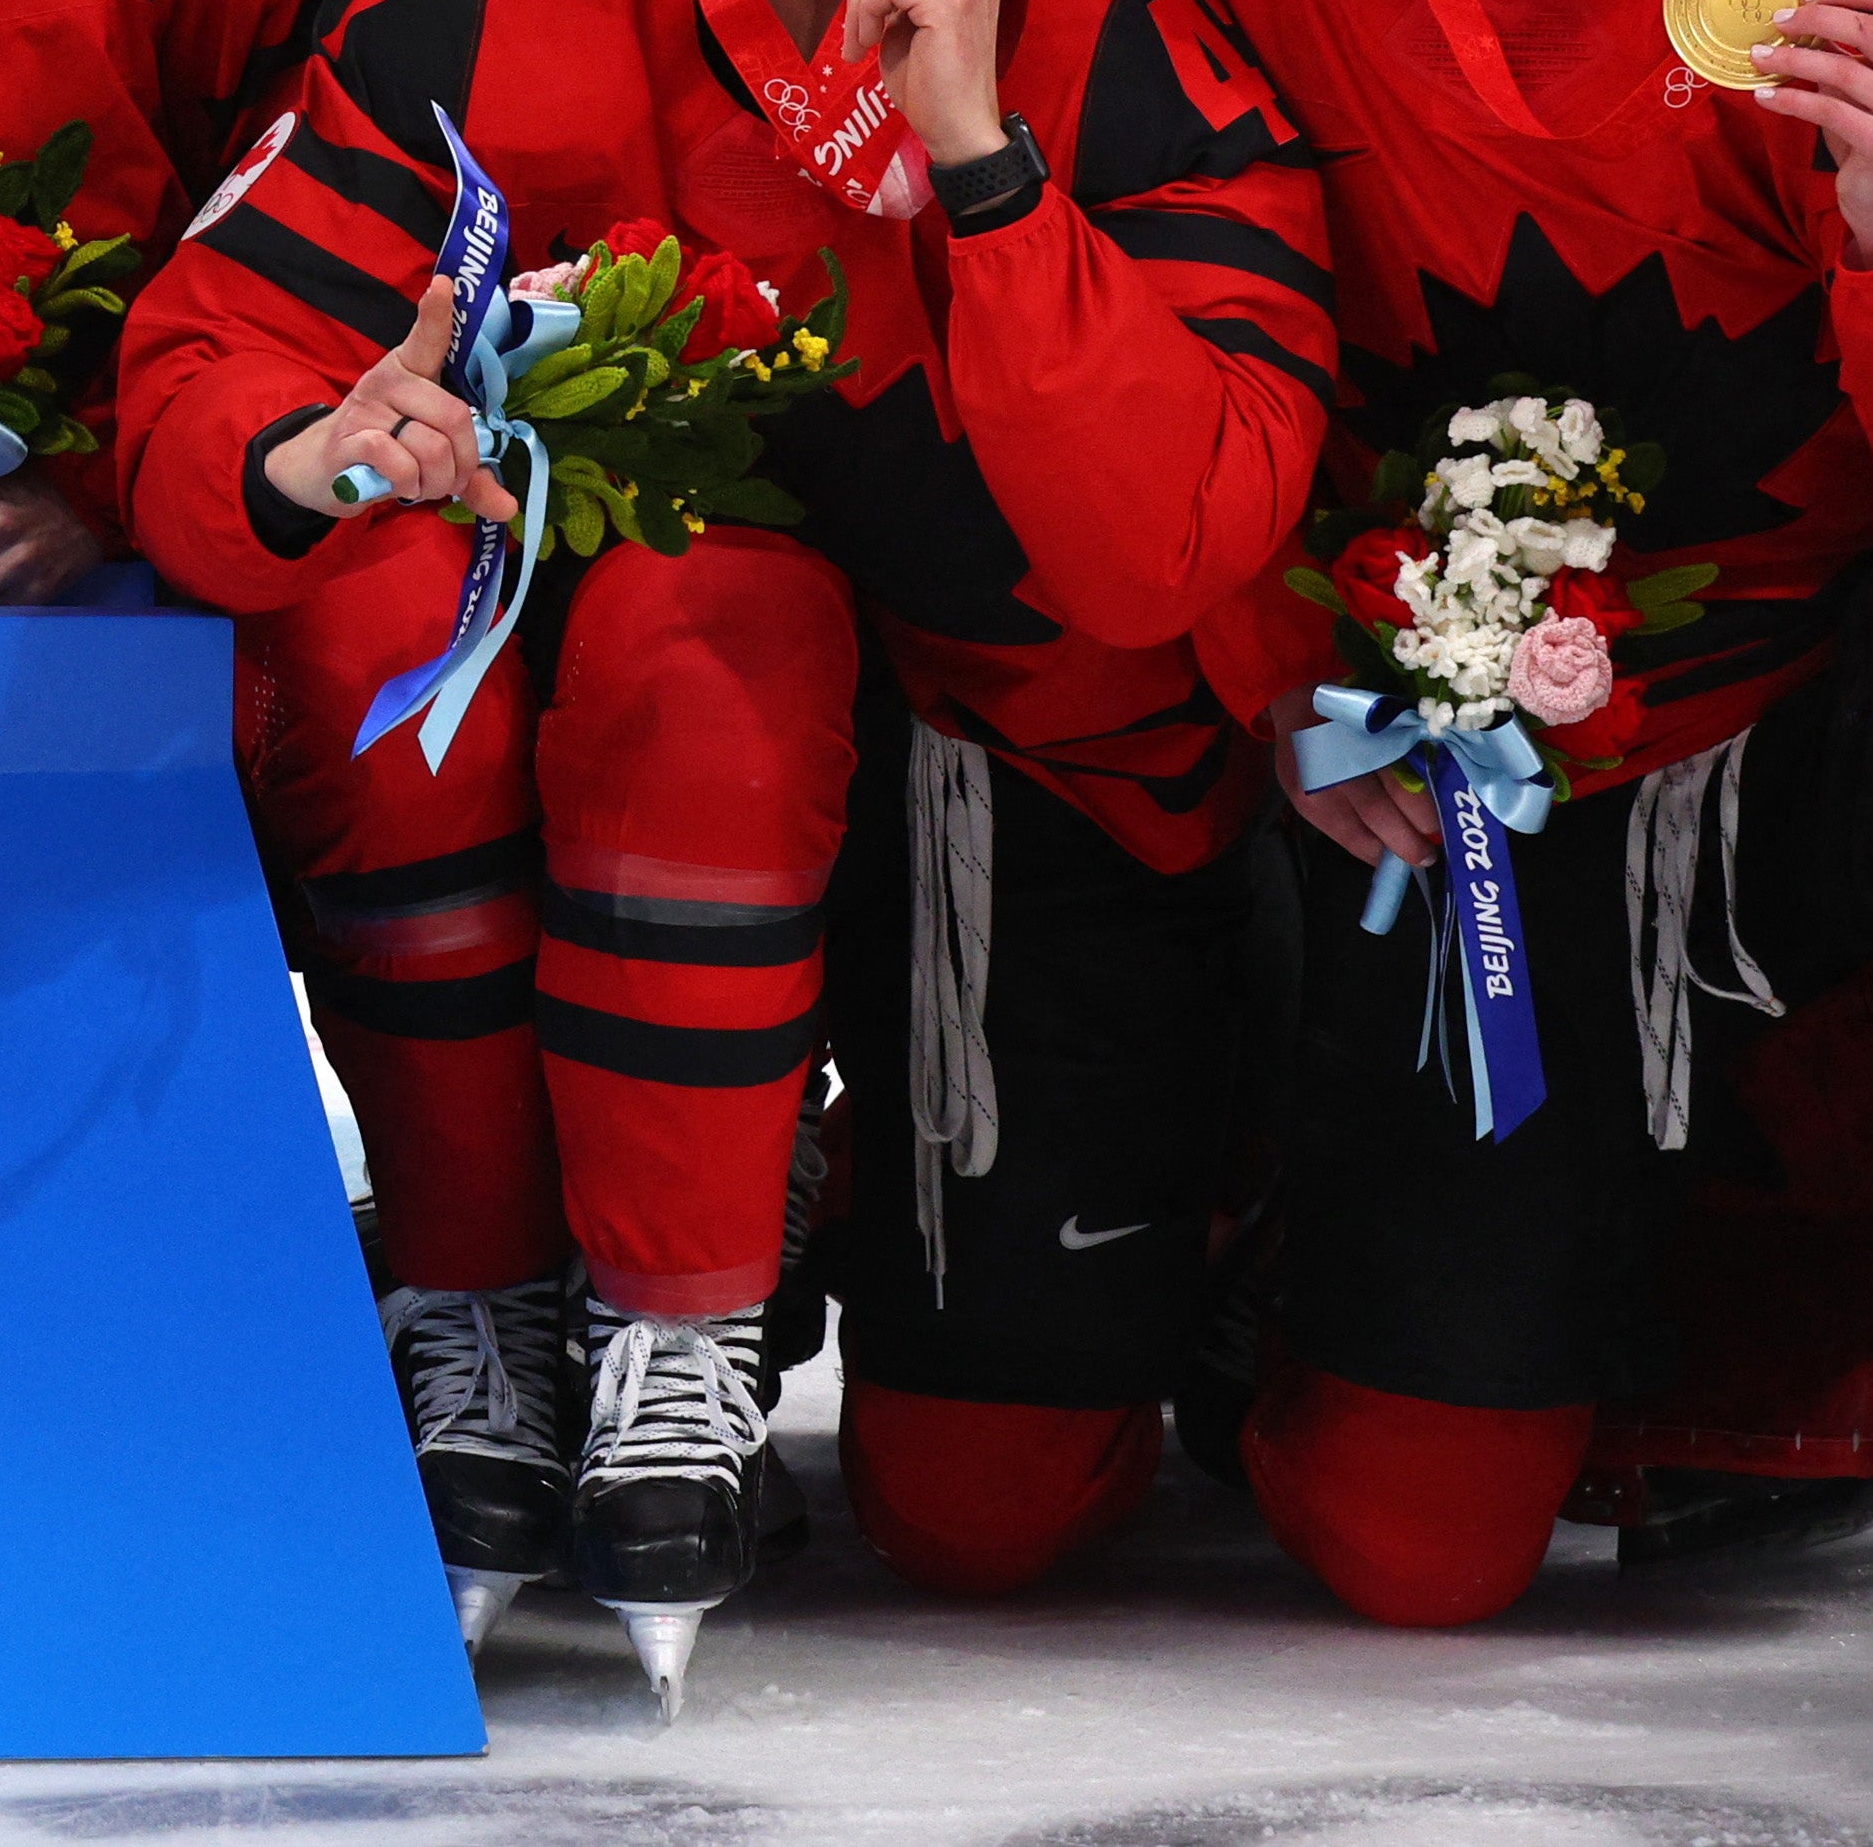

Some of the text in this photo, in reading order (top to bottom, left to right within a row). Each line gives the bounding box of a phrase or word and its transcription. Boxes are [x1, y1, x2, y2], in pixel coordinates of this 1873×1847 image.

[452, 186, 499, 304] BEIJING
[1454, 783, 1516, 1000] BEIJING 2022
